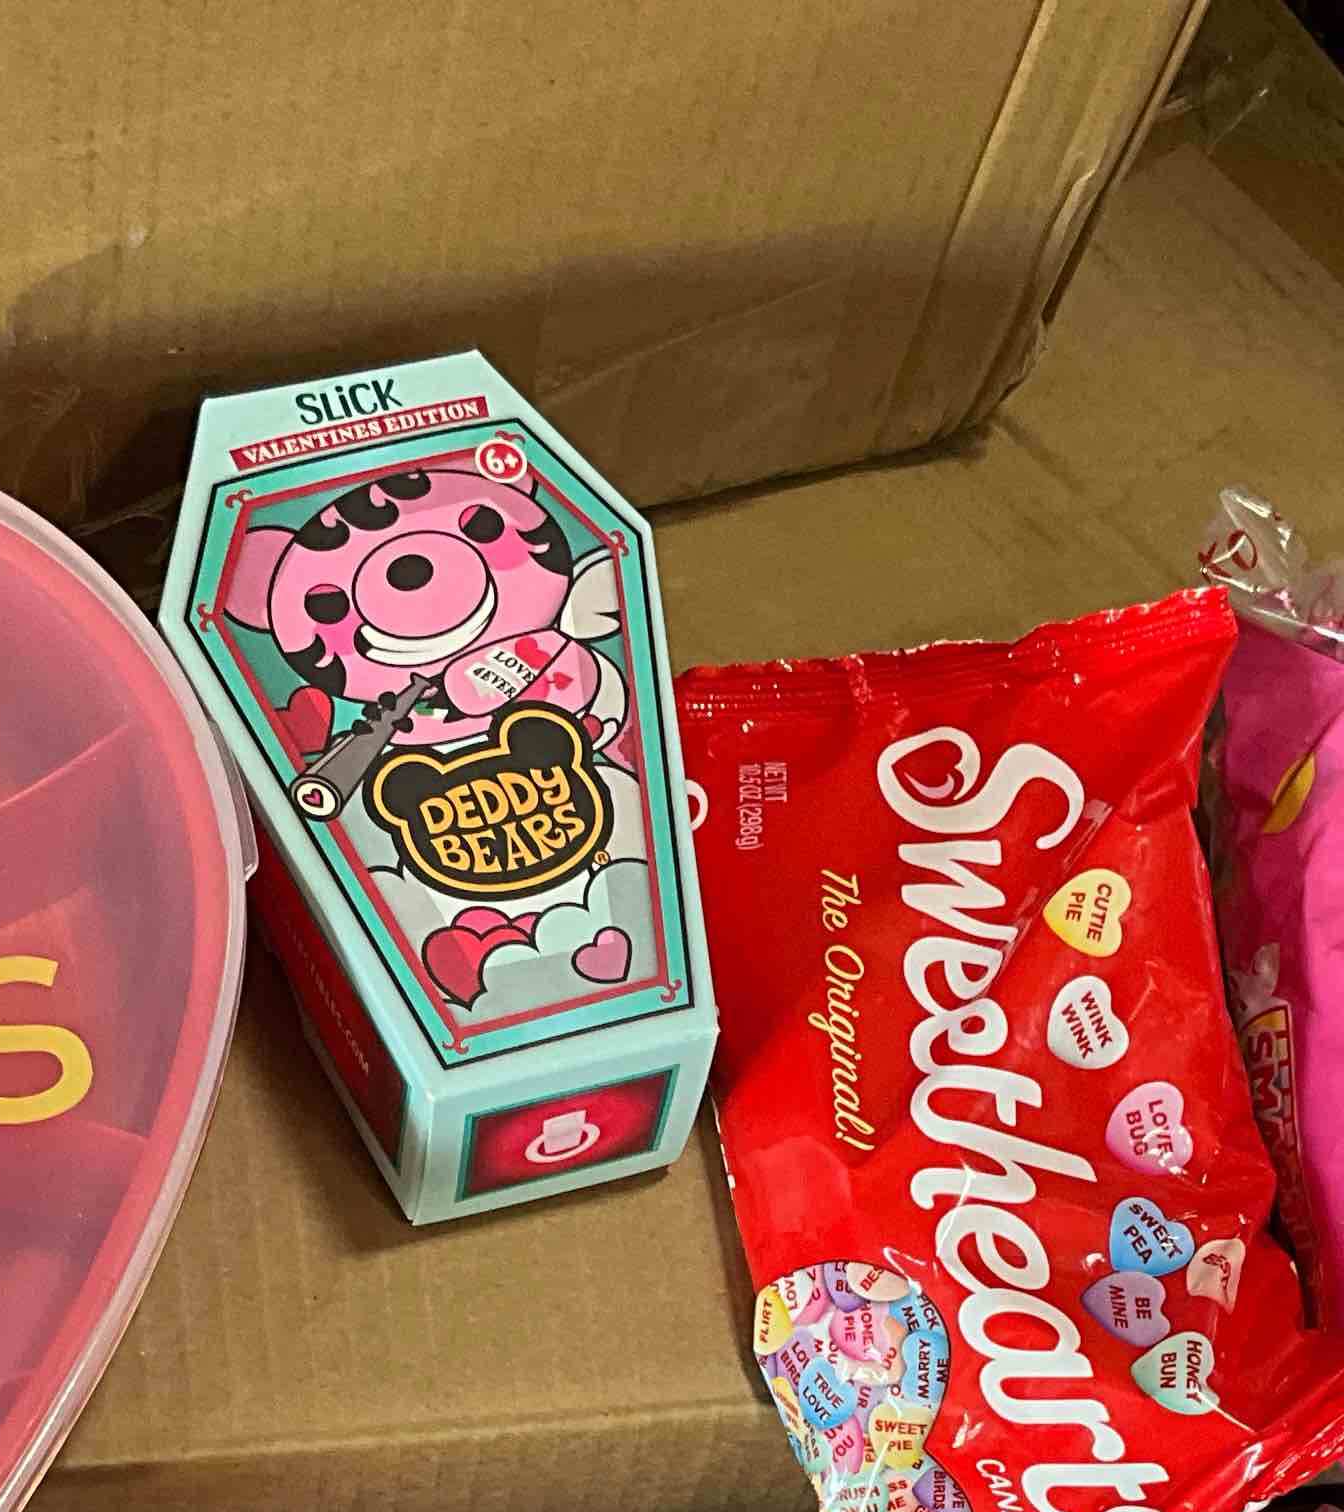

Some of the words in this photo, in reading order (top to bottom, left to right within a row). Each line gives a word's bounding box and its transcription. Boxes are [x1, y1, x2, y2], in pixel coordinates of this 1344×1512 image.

[242, 414, 383, 465] VALENTINES
[383, 399, 481, 434] EDITION
[484, 448, 520, 475] 6+
[472, 666, 519, 699] 4EVER
[493, 650, 537, 685] LOVE
[764, 761, 788, 782] NET
[418, 765, 572, 835] DEDDY
[430, 802, 586, 874] BEARS
[735, 804, 764, 851] (298g)
[821, 868, 863, 932] The
[1065, 891, 1086, 922] PIE
[1086, 883, 1113, 942] CUTIE
[1061, 1003, 1094, 1060] WINK
[1081, 990, 1114, 1048] WINK
[808, 944, 876, 1153] Original!
[1125, 1110, 1148, 1156] BUG
[1123, 1225, 1154, 1264] PEA
[759, 1297, 774, 1345] FLIRT
[1109, 1284, 1129, 1330] MINE
[1135, 1296, 1153, 1320] BE
[779, 1352, 802, 1388] BIRD
[791, 1341, 812, 1369] LOV
[917, 1338, 932, 1399] MARRY
[1160, 1352, 1177, 1389] BUN
[1186, 1339, 1204, 1404] HONEY
[814, 1372, 845, 1409] TRUE
[874, 1418, 929, 1436] SWEET
[837, 1485, 881, 1502] RUSH
